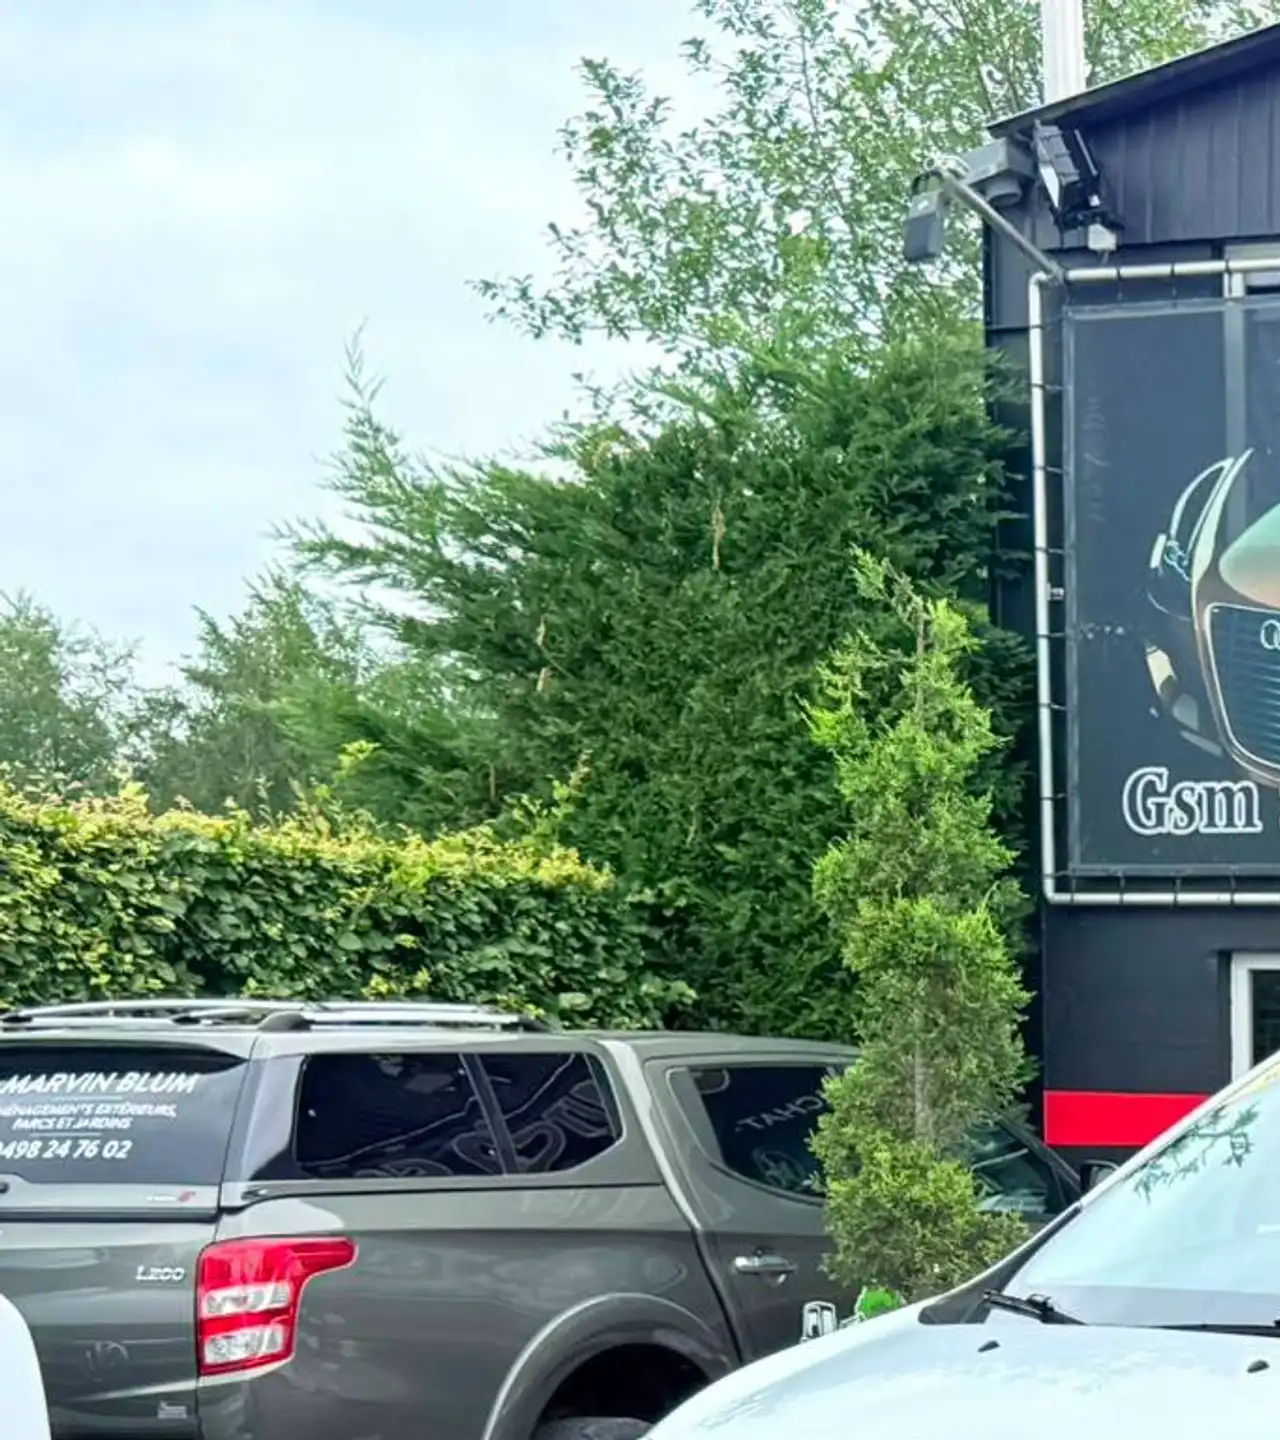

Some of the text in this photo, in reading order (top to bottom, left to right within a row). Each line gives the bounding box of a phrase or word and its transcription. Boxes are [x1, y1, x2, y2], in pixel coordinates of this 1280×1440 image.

[1122, 766, 1263, 835] Gsm
[0, 1072, 201, 1094] MARVIN BLUM
[42, 1140, 72, 1159] 24
[73, 1139, 101, 1159] 76
[102, 1140, 134, 1159] 02
